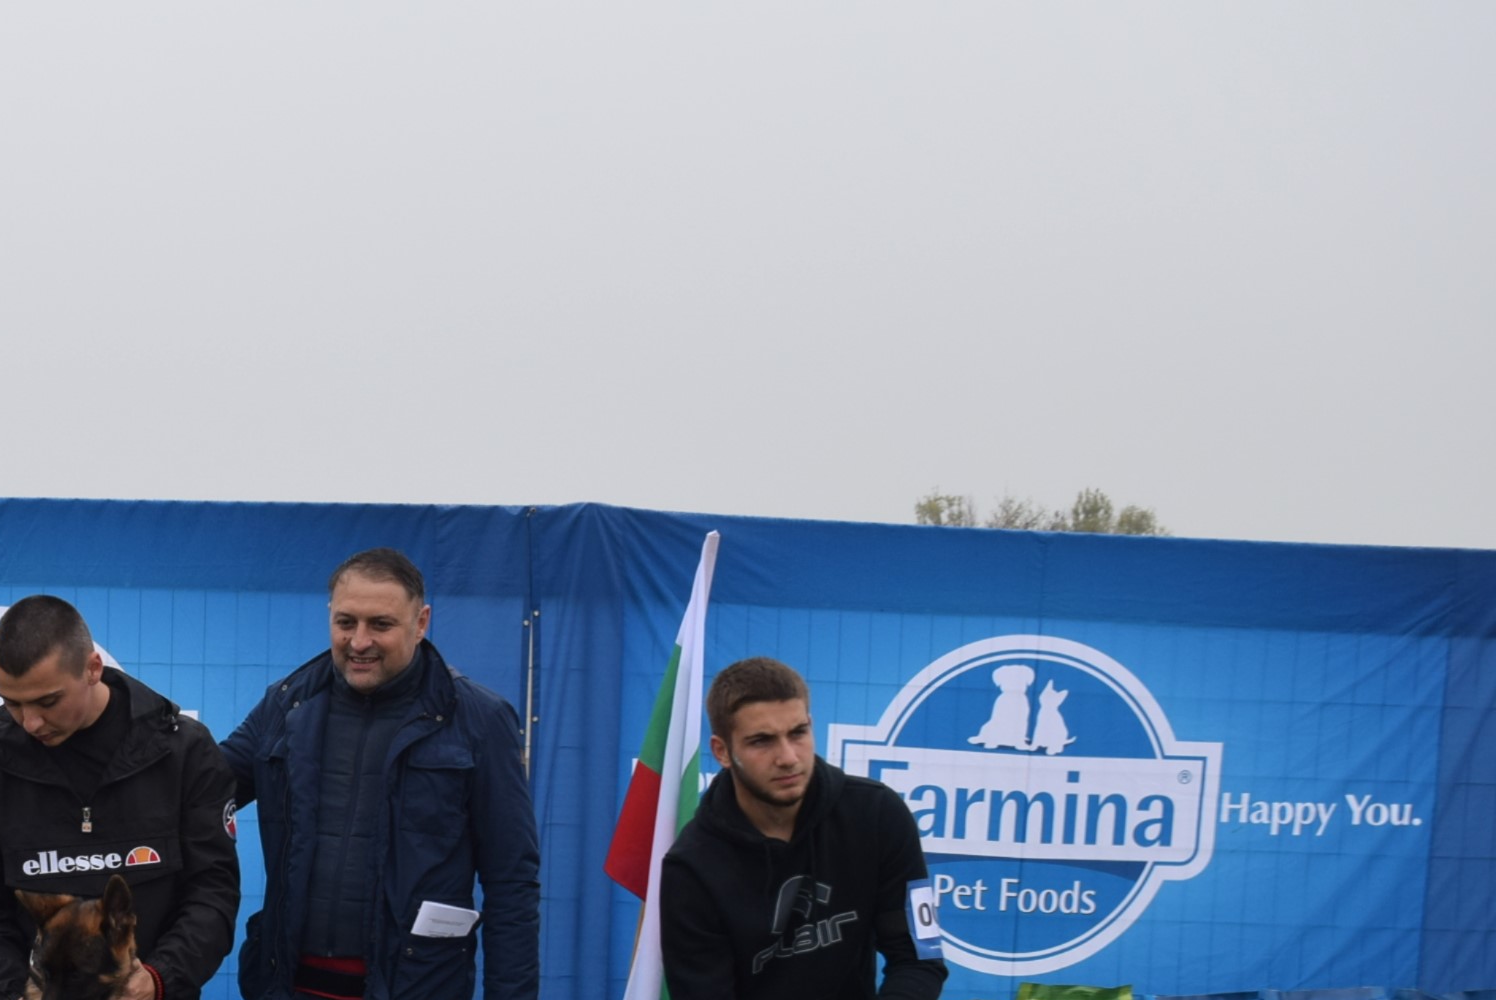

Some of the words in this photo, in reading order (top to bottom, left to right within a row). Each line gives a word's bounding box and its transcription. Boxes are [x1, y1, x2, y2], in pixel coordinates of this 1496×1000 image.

[1219, 791, 1337, 837] Happy
[1344, 794, 1423, 827] You.
[22, 850, 123, 876] ellesse
[933, 874, 988, 912] Pet
[998, 878, 1097, 916] Foods
